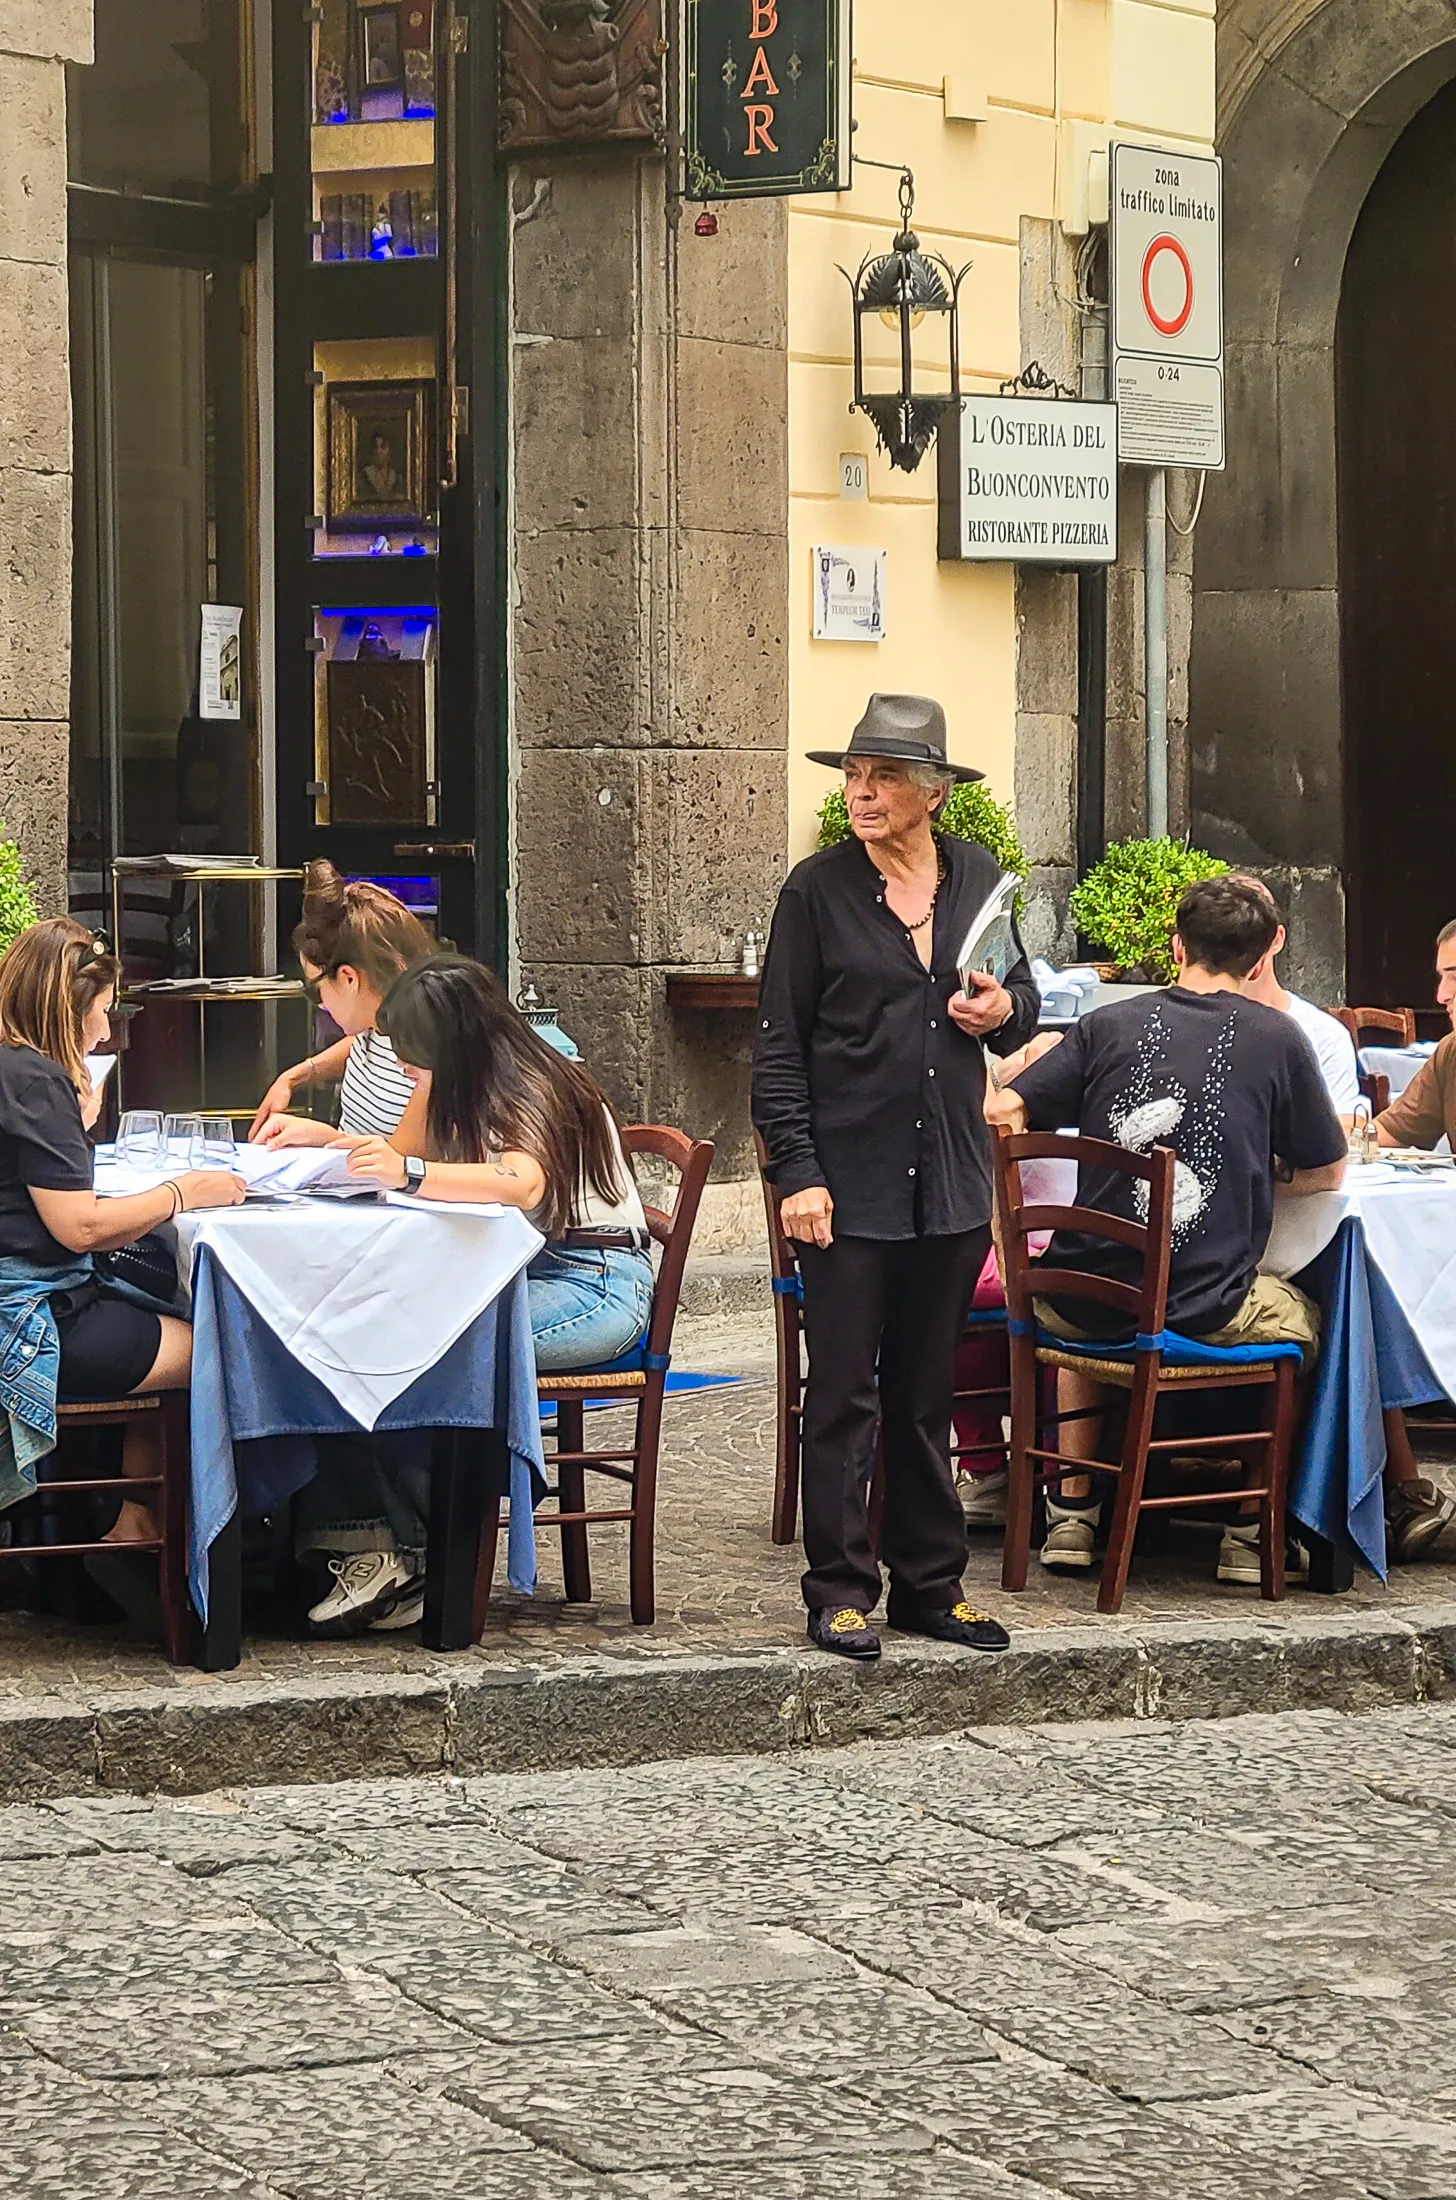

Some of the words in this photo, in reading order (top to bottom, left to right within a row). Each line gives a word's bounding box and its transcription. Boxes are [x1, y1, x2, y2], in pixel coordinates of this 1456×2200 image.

[740, 0, 780, 156] BAR
[1155, 168, 1180, 187] zona
[1120, 187, 1165, 215] traffico
[1169, 193, 1216, 222] limitato
[971, 414, 1067, 447] L'OSTERIA
[1072, 424, 1106, 449] DEL
[845, 464, 863, 488] 20
[967, 467, 1110, 500] BUONCONVENTO
[967, 519, 1048, 544] RISTORANTE
[1051, 521, 1110, 546] PIZZERIA
